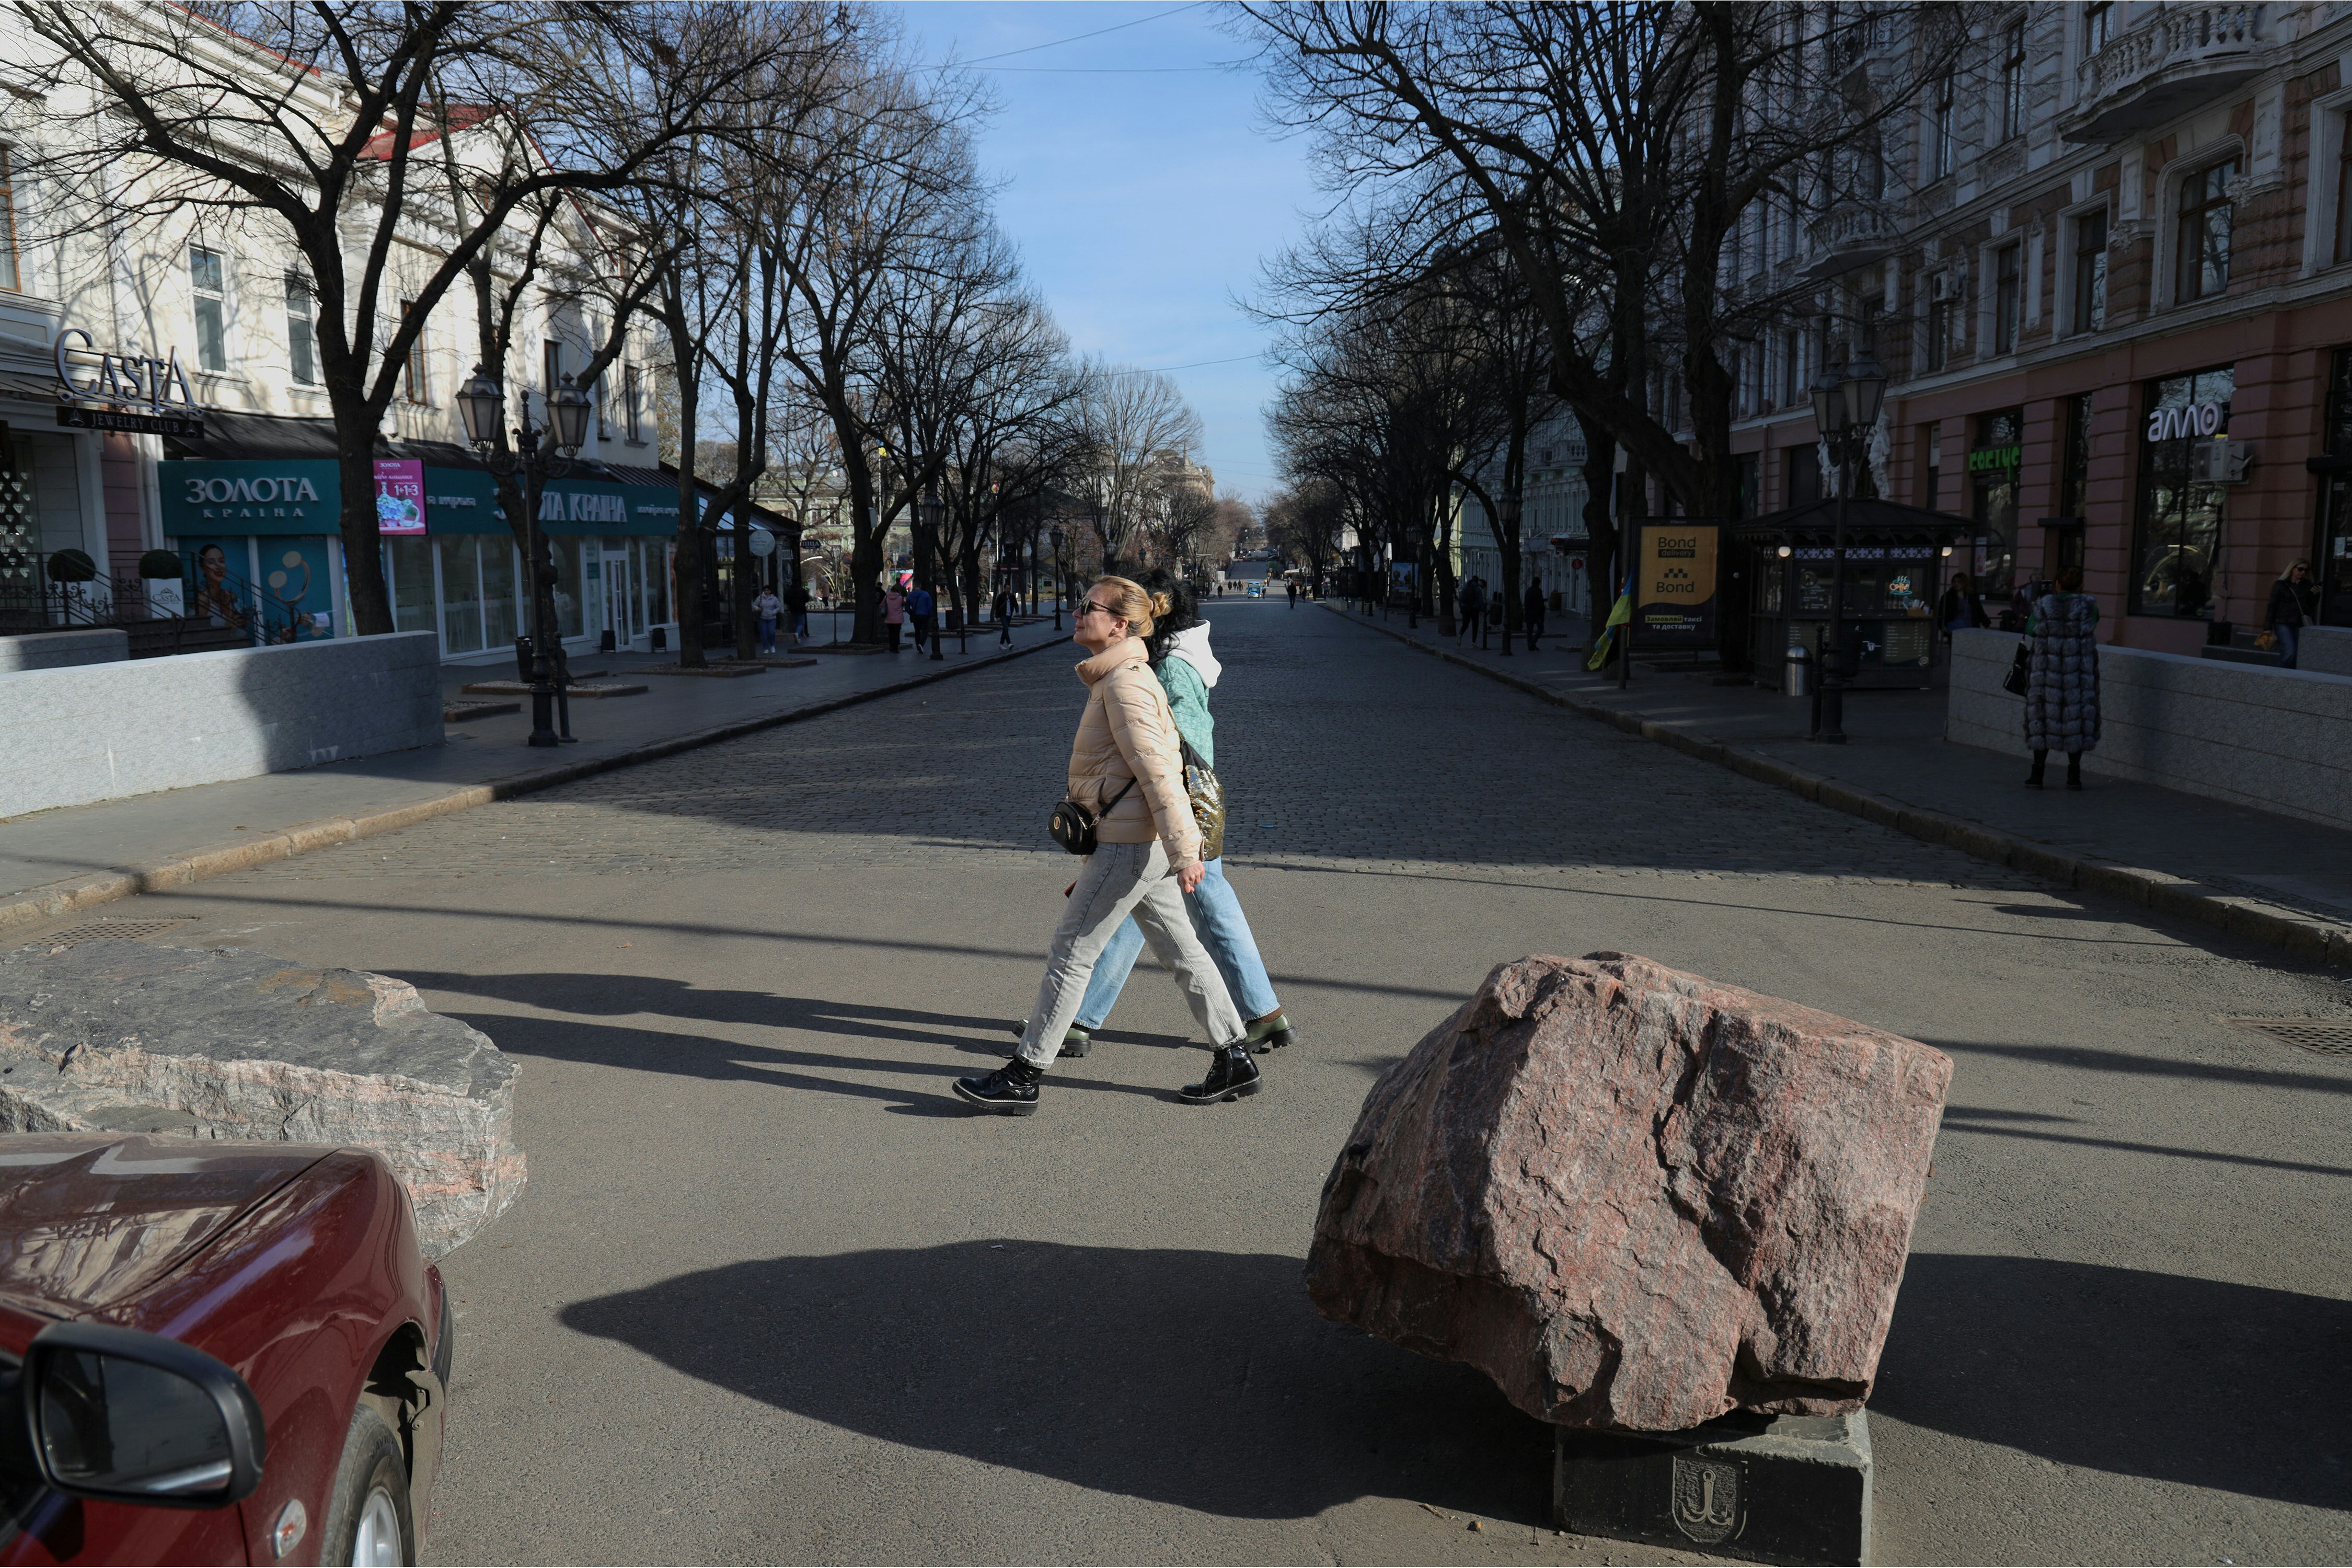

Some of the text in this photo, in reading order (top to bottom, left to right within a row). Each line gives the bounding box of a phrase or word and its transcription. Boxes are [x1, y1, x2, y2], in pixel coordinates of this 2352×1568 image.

[54, 329, 196, 413] CASTA
[92, 413, 180, 433] JEWELRY CLUB
[185, 477, 320, 504] ЗОЛОТА
[394, 485, 419, 496] 1+1=3
[1658, 537, 1696, 548] Bond
[1657, 581, 1694, 592] Bond
